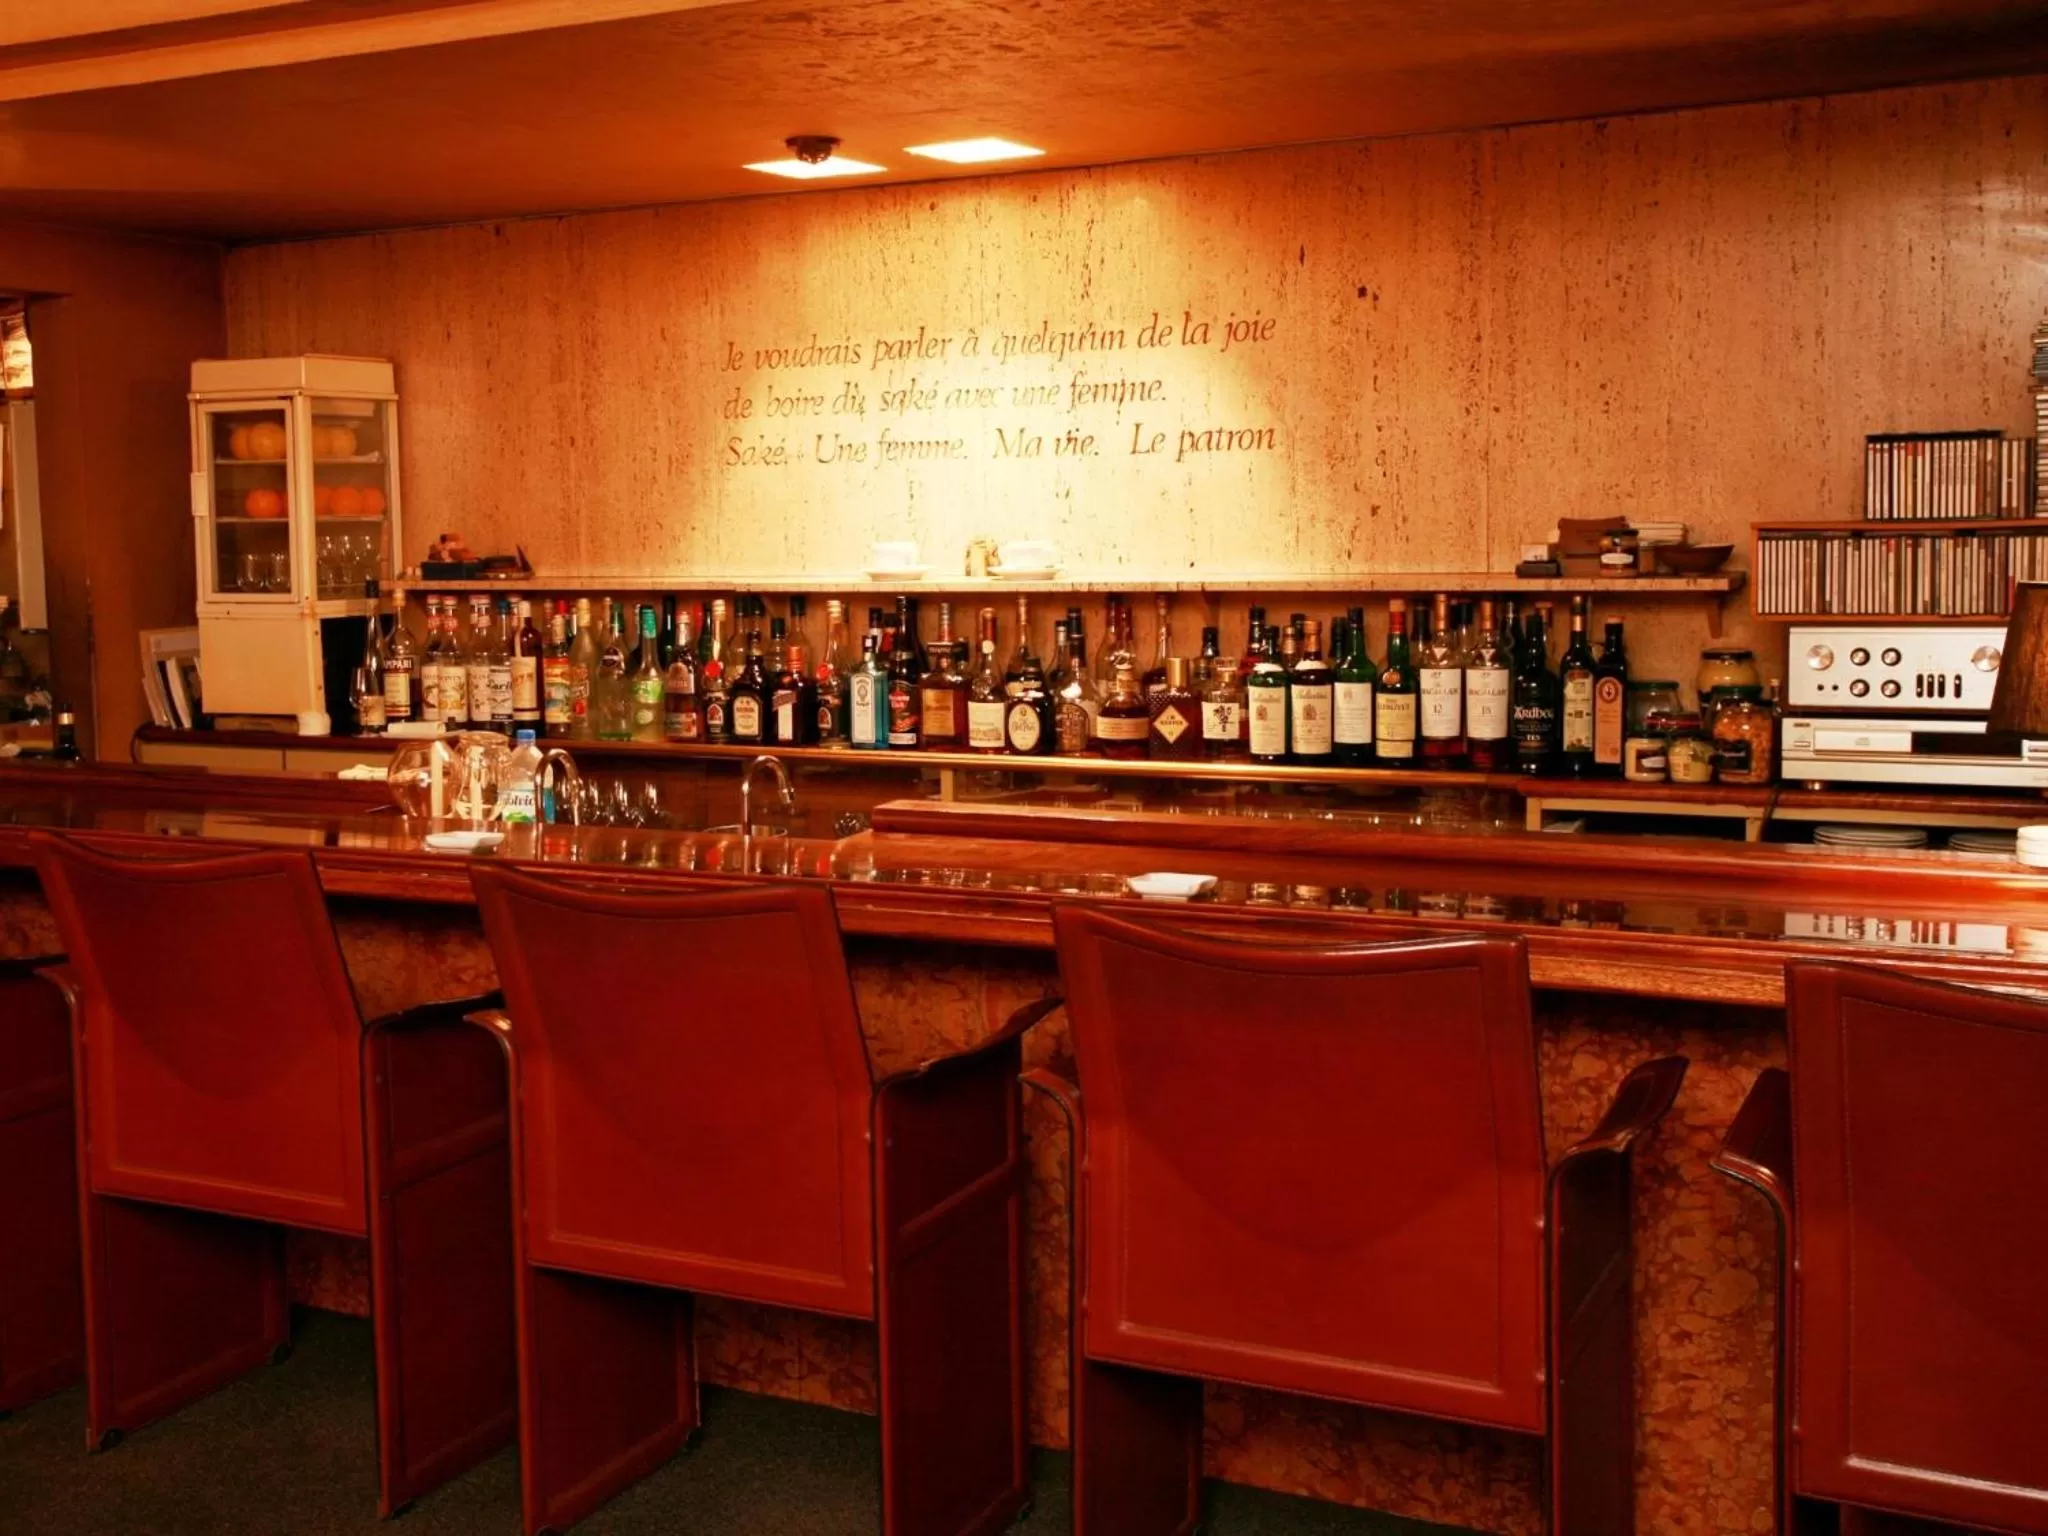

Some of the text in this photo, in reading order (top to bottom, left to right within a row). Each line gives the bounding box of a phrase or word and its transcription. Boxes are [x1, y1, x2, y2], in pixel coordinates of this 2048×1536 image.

[721, 309, 1276, 372] Je voudrais parler à quelqu'un de la joie
[723, 387, 753, 420] de
[766, 385, 825, 419] boire
[879, 378, 939, 413] saké
[944, 387, 1004, 408] avec
[1012, 384, 1061, 407] une
[1066, 370, 1166, 413] femme.
[815, 433, 868, 464] Une
[874, 428, 968, 470] femme.
[992, 427, 1042, 459] Ma
[1054, 428, 1099, 457] vie.
[1129, 422, 1166, 454] Le
[1175, 426, 1276, 462] patron
